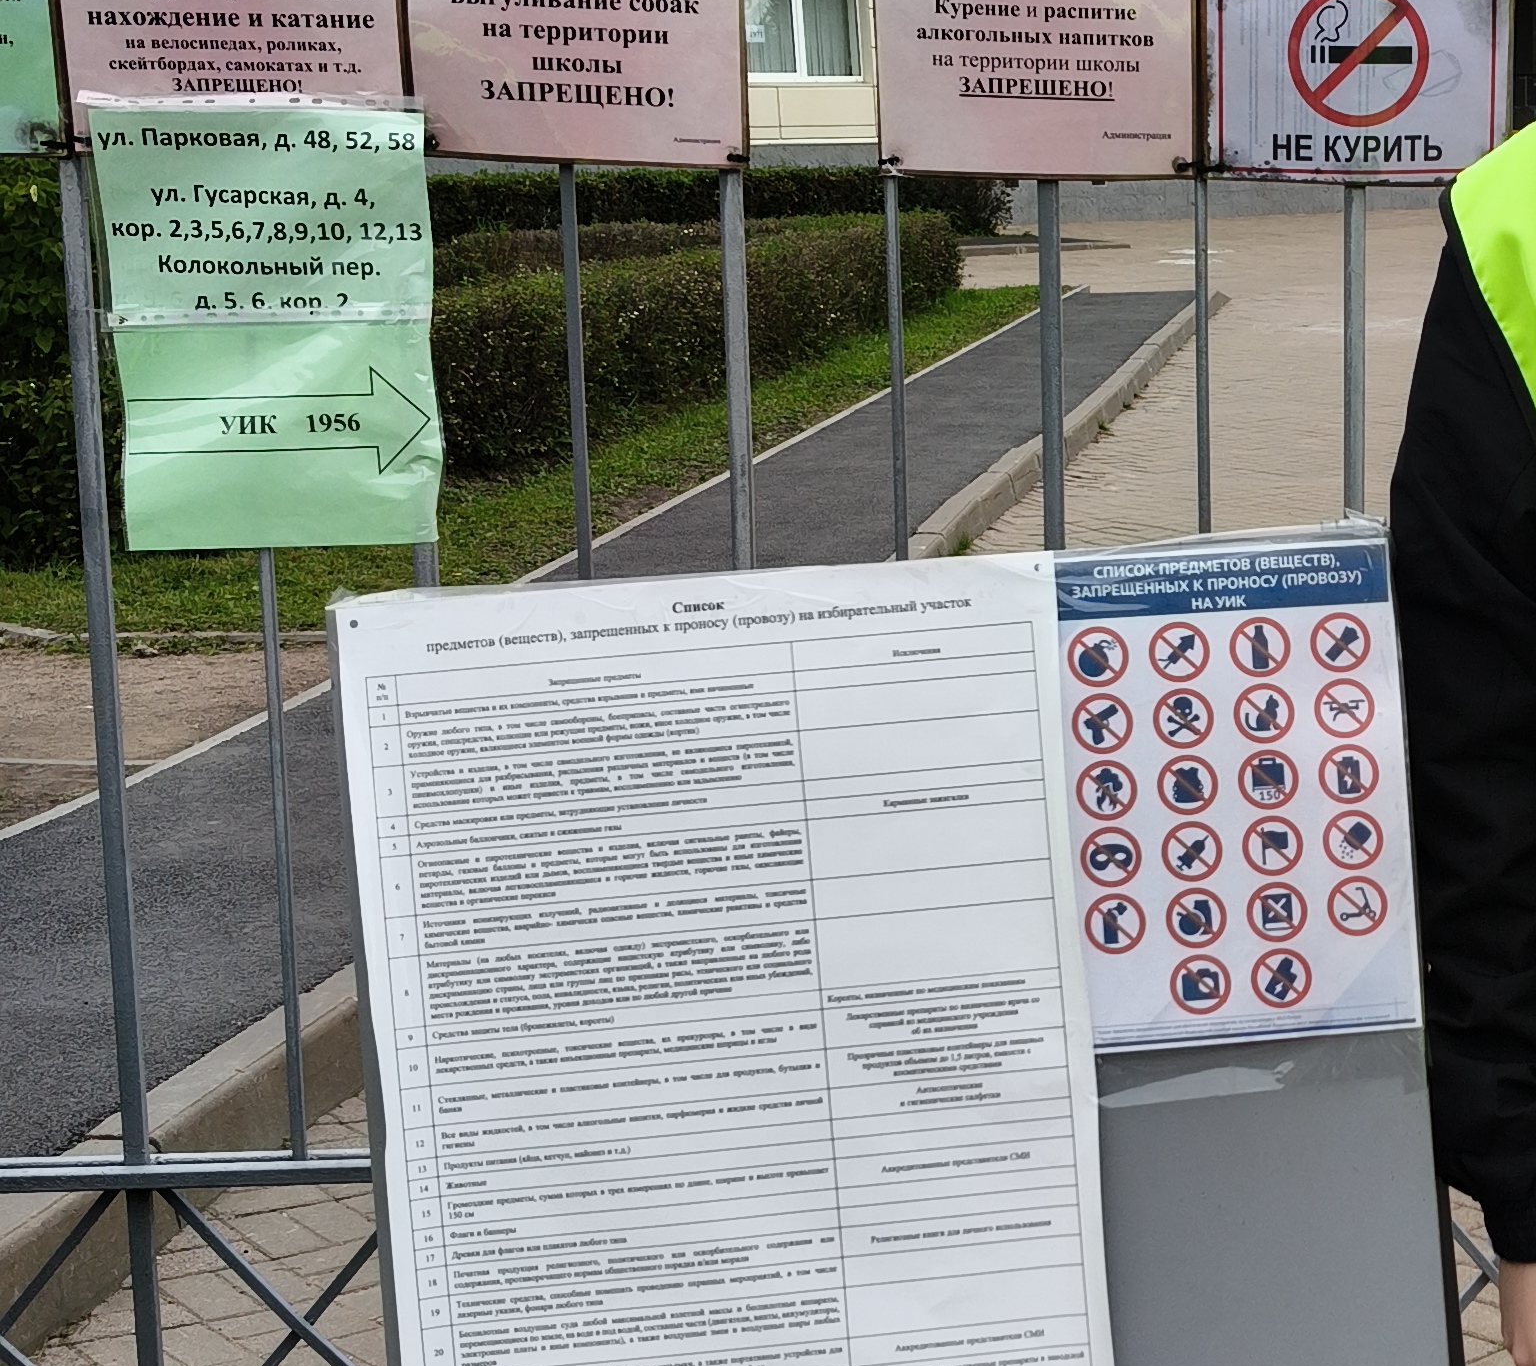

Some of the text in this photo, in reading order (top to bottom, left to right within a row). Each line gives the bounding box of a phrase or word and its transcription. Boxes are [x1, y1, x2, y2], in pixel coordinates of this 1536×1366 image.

[86, 10, 375, 30] нахождение и катание
[1026, 5, 1038, 18] и
[1044, 5, 1137, 23] распитие
[482, 22, 669, 49] на территории
[916, 27, 1155, 47] алкогольных напитков
[125, 38, 342, 55] на велосипедах, роликах,
[108, 56, 362, 75] скейтбордах, самокатах и т.д.
[531, 56, 623, 74] школы
[932, 54, 1140, 75] на территории школы
[171, 77, 305, 95] ЗАПРЕЩЕНО!
[480, 79, 674, 110] ЗАПРЕЩЕНО!
[97, 127, 415, 154] ул. Парковая, д. 48, 52, 58
[1101, 130, 1172, 142] Администрация
[1272, 133, 1443, 167] НЕ КУРИТЬ
[150, 184, 375, 210] ул. Гусарская, д. 4,
[111, 222, 162, 242] кор.
[359, 222, 423, 245] 12,13
[158, 254, 381, 281] Колокольный пер.
[194, 295, 217, 310] д.
[279, 296, 330, 309] кор
[218, 412, 361, 435] УИК 1956
[1093, 554, 1342, 579] СПИСОК ПРЕДМЕТОВ (ВЕЩЕСТВ),
[1071, 569, 1363, 599] ЗАПРЕЩЕННЫХ К ПРОНОСУ (ПРОВОЗУ)
[671, 598, 724, 614] Список
[1191, 594, 1247, 611] НА УИК
[426, 598, 972, 655] предметов (веществ), запрещенных к проносу (провозу) на избирательный участок
[1259, 790, 1280, 801] 150
